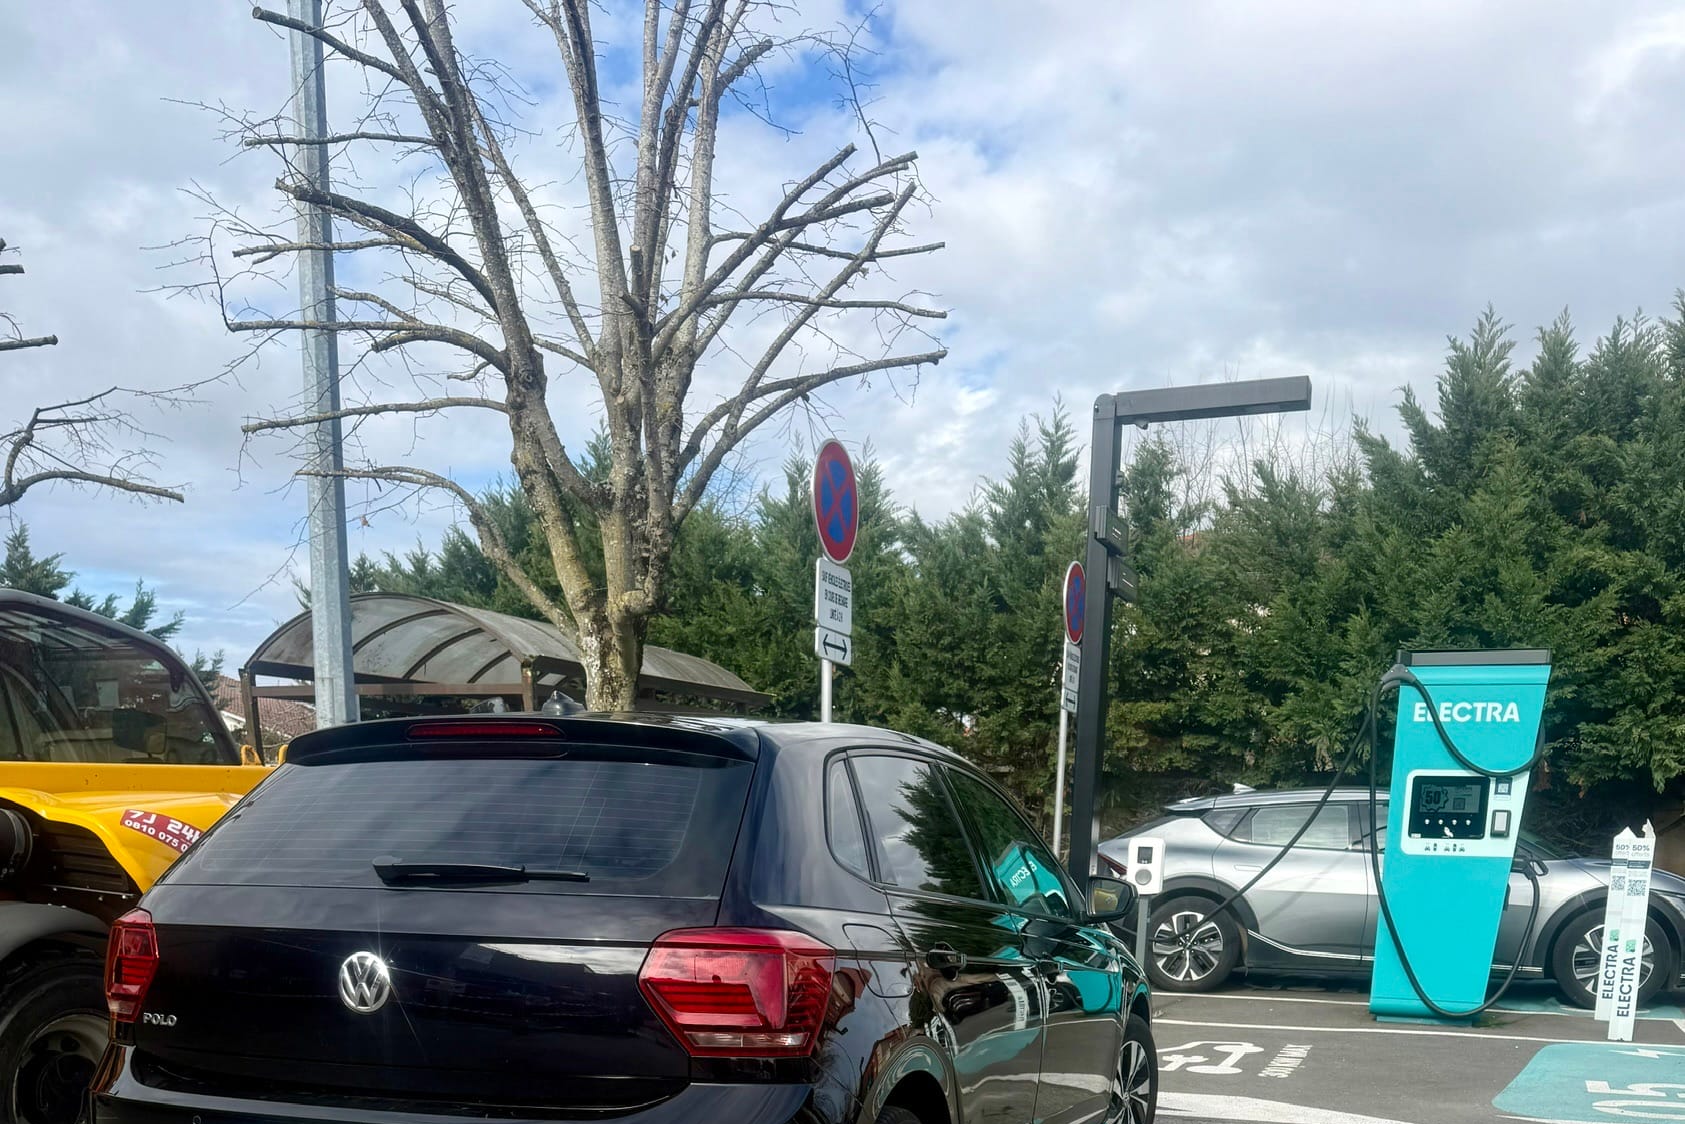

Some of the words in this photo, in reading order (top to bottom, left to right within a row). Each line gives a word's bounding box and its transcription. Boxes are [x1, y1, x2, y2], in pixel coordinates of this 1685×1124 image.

[124, 819, 156, 836] 0810
[158, 831, 180, 848] 075
[1602, 944, 1619, 1000] ELECTRA
[1617, 956, 1636, 1017] ELECTRA
[143, 1012, 177, 1026] POLO
